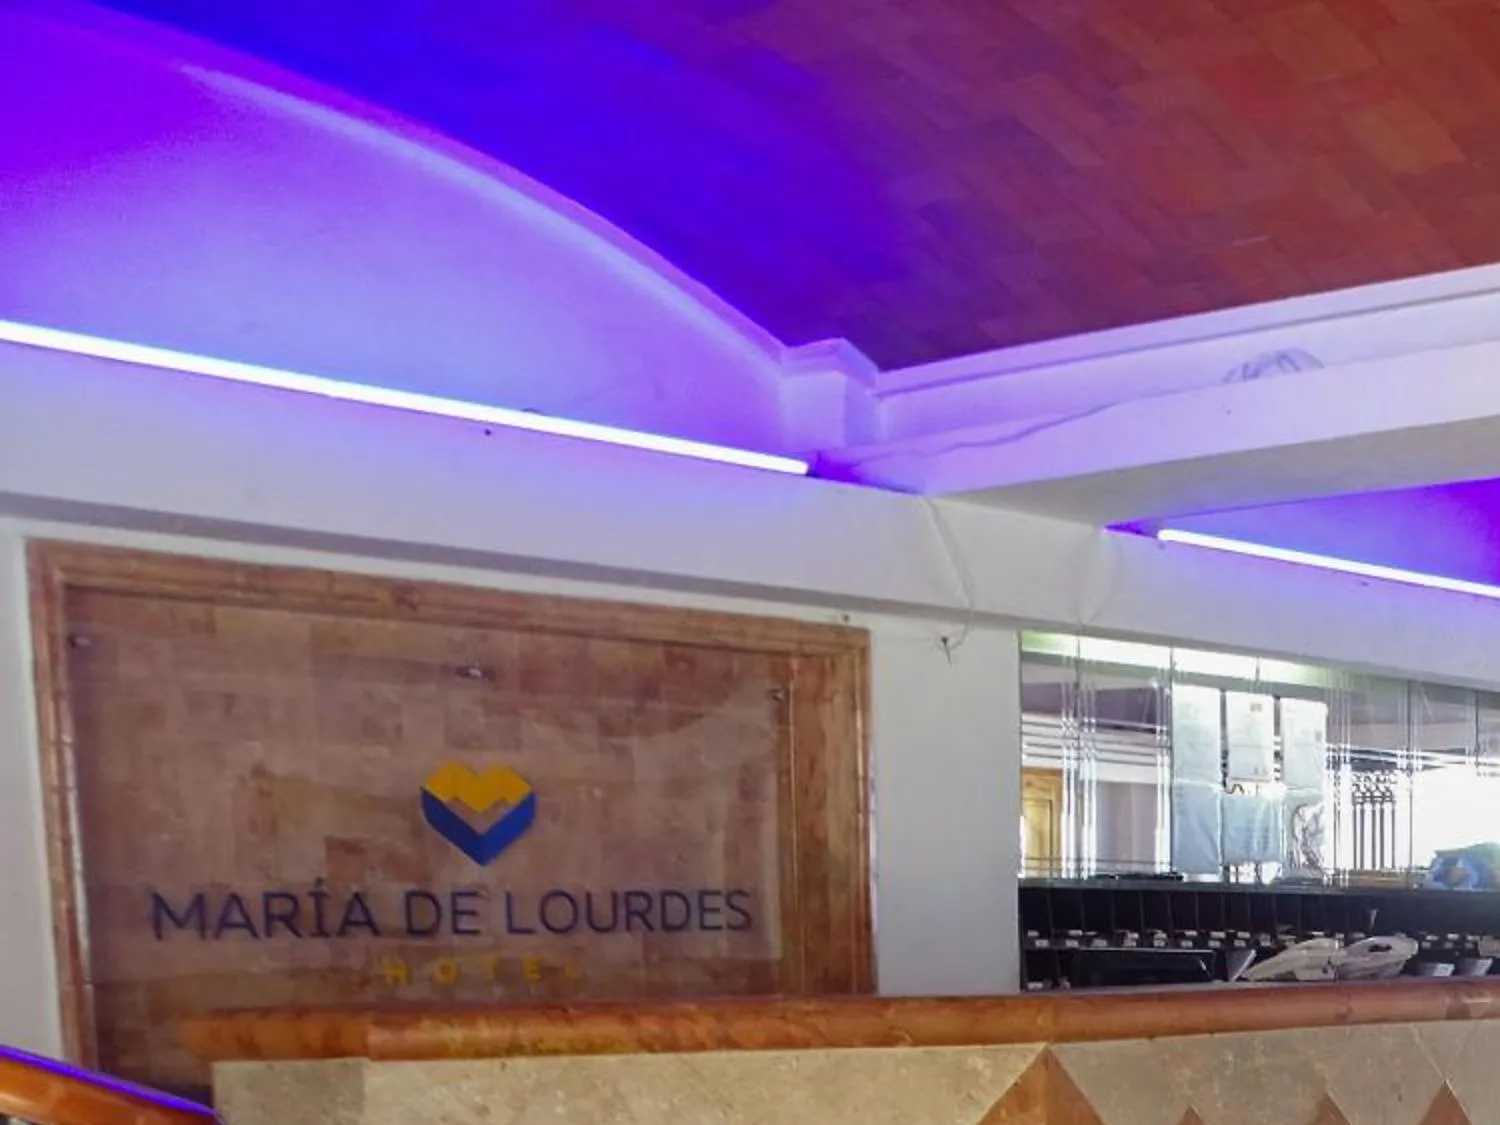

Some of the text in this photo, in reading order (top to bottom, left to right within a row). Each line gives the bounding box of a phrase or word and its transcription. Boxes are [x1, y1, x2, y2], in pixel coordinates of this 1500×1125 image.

[151, 877, 752, 941] MARÍA DE LOURDES
